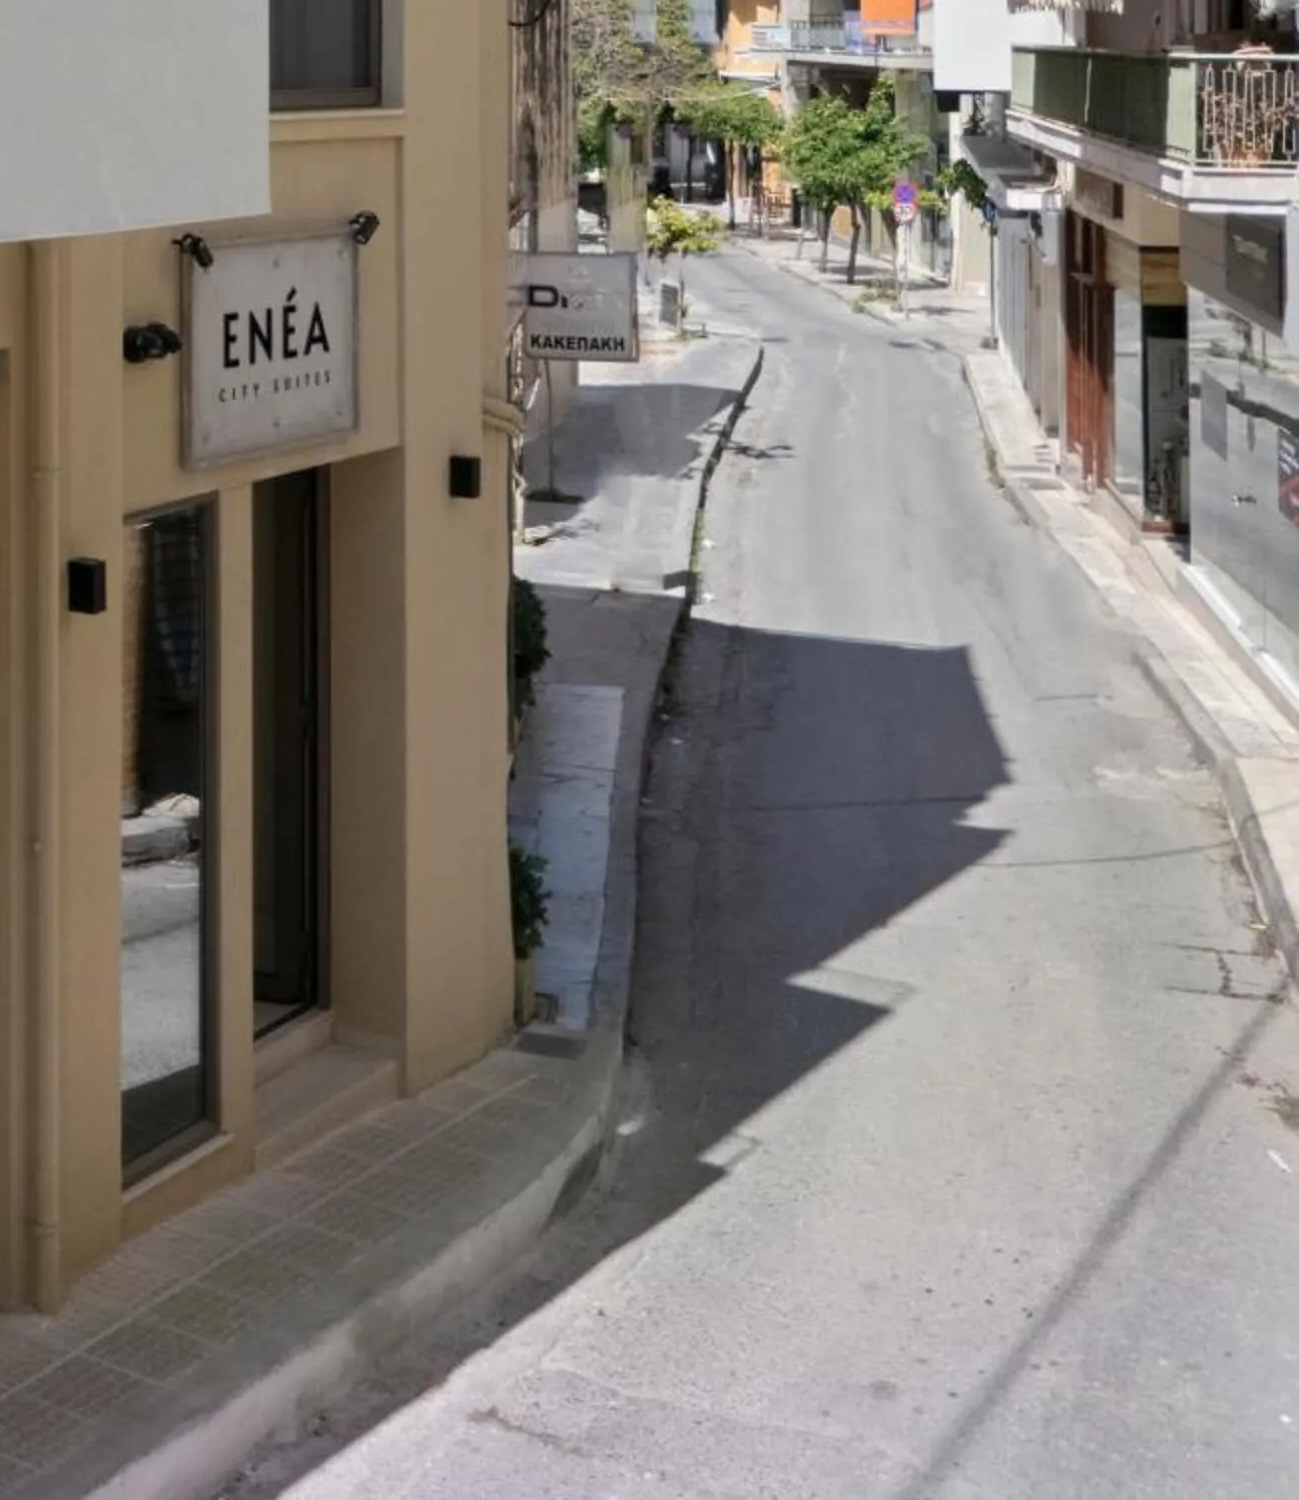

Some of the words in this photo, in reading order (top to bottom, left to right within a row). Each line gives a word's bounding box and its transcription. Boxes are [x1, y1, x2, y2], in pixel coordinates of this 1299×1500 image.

[222, 285, 331, 369] ENÉA
[217, 382, 261, 403] CITY
[272, 369, 331, 394] SUITES
